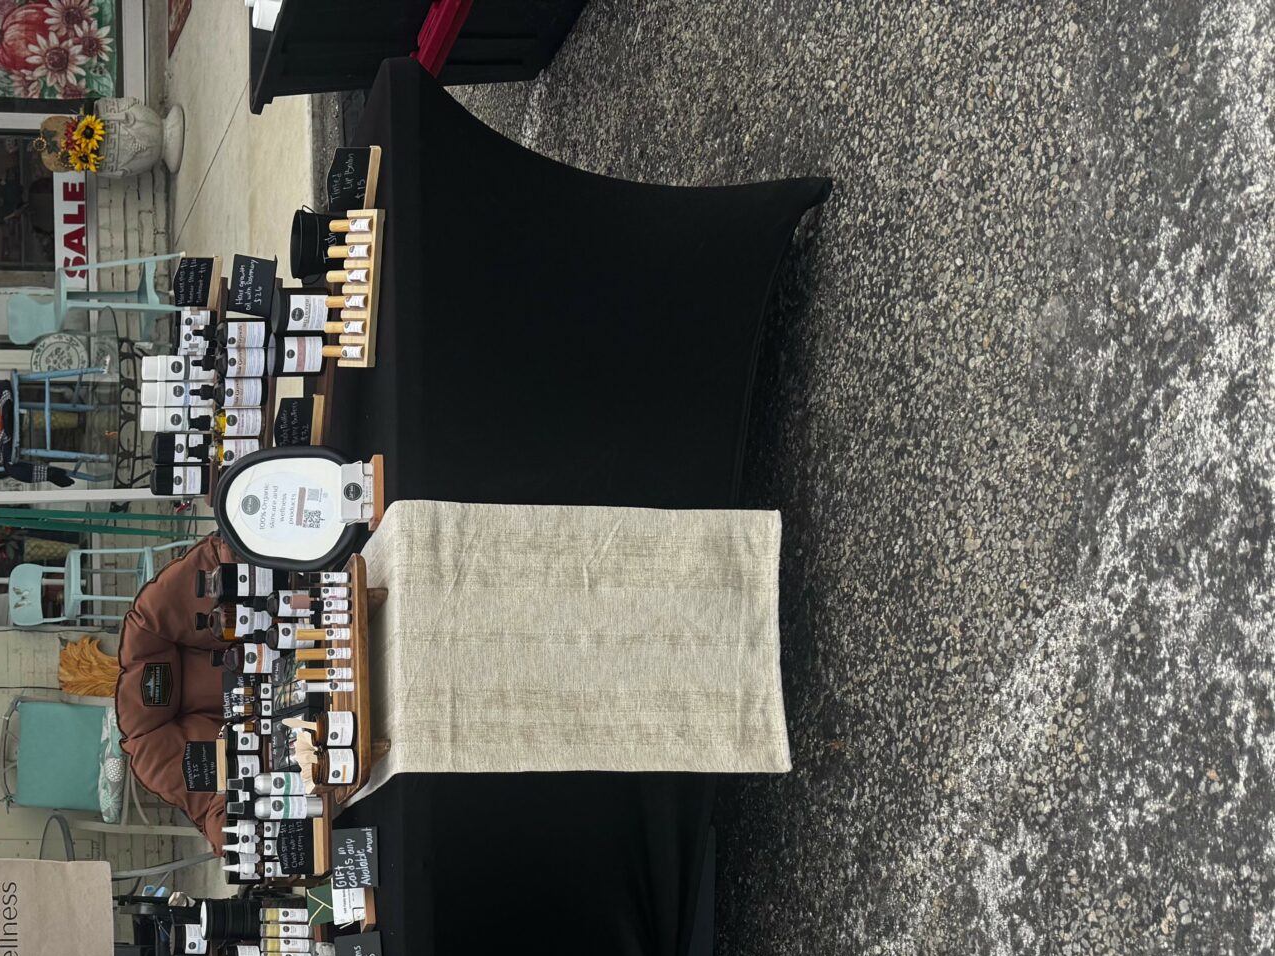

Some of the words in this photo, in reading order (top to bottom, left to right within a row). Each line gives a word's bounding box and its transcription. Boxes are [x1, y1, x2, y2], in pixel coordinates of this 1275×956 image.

[330, 173, 341, 204] Tinted
[61, 181, 87, 280] SALE
[322, 232, 338, 264] Tsh
[235, 289, 243, 305] Hair
[261, 483, 269, 510] Organic
[279, 493, 287, 522] wellness
[289, 493, 297, 524] products
[345, 838, 355, 854] any
